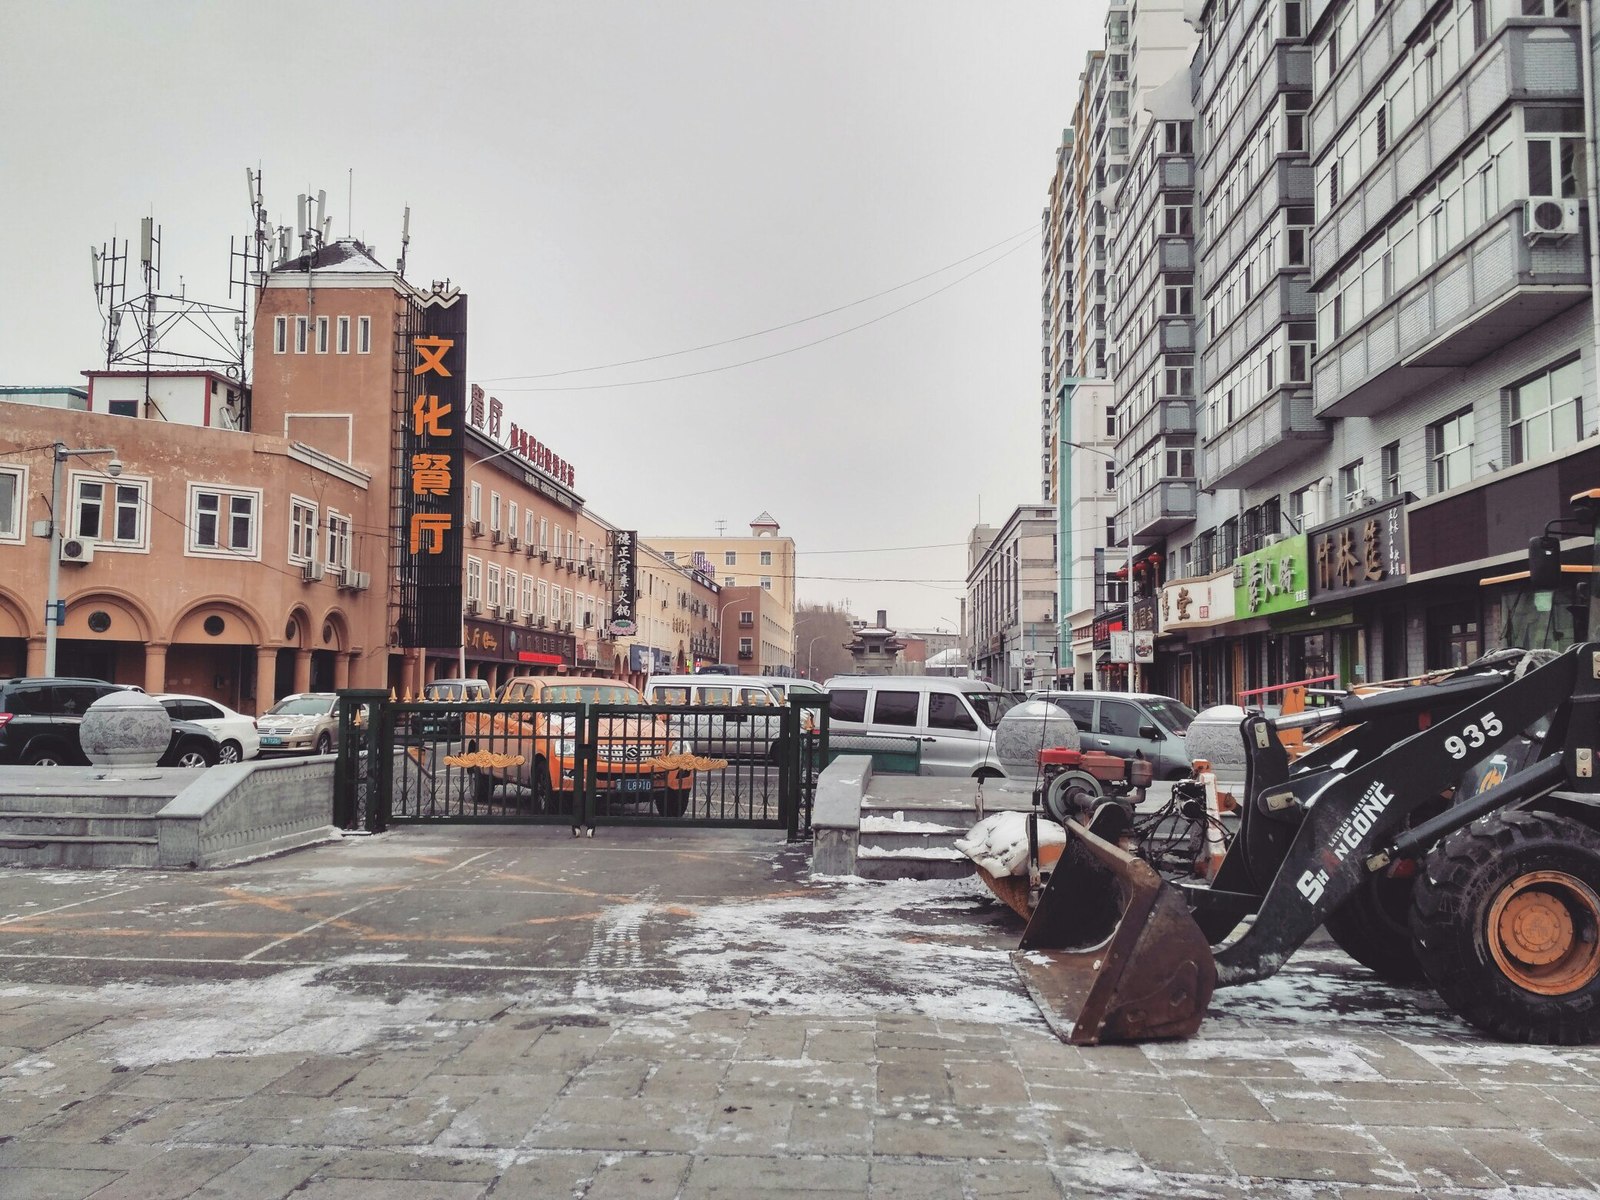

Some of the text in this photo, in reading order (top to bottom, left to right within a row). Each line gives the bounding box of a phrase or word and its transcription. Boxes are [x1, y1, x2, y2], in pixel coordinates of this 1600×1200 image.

[410, 335, 454, 555] 文化餐厅
[1444, 711, 1503, 760] 935
[1328, 780, 1379, 848] LAIZHOU SHANGONG
